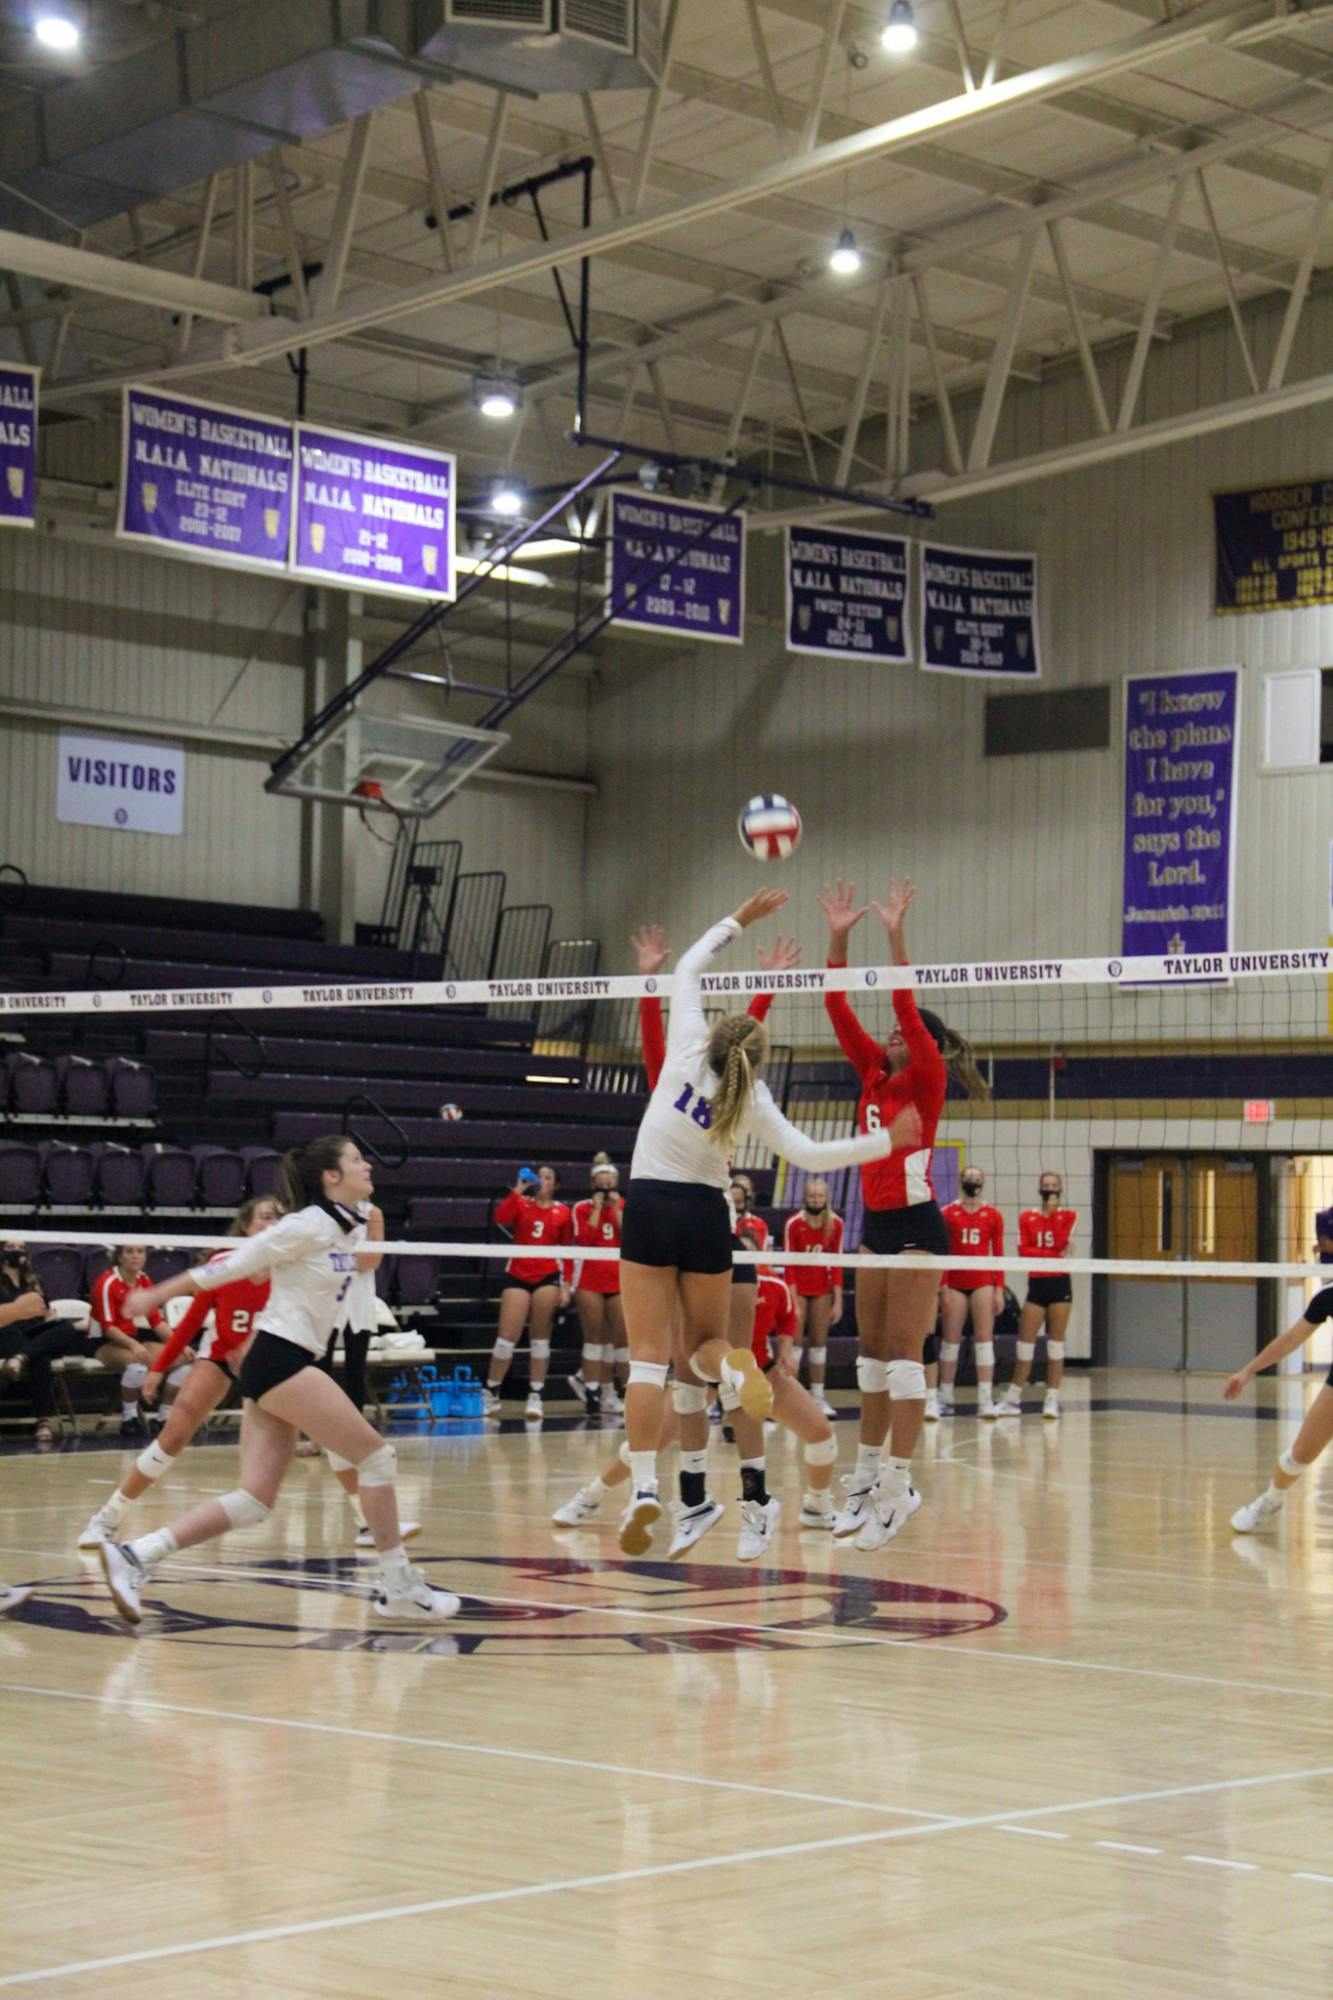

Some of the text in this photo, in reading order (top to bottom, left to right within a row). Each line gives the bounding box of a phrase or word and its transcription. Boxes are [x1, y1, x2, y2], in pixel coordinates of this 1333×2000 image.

[0, 384, 33, 410] ALL
[132, 402, 292, 459] WOMEN'S BASKETBALL
[199, 454, 289, 494] NATIONALS
[301, 446, 450, 499] WOMEN'S BASKETBALL
[362, 493, 444, 530] NATIONALS
[840, 575, 904, 600] NATIONALS
[1160, 690, 1226, 715] know
[1129, 722, 1231, 753] the plans
[68, 756, 175, 795] VISITORS
[1146, 757, 1215, 783] I have
[1132, 792, 1165, 817] for
[1133, 825, 1222, 857] says the
[1148, 859, 1206, 887] Lord.
[915, 963, 1062, 984] TAYLOR UNIVERSITY
[1163, 952, 1329, 975] TAYLOR UNIVERSITY
[302, 986, 413, 1002] TAYLOR UNIVERSITY
[489, 980, 611, 997] TAYLOR UNIVERSITY
[701, 973, 825, 991] AYLOR UNIVERSITY
[9, 996, 66, 1009] UNIVERSITY
[130, 992, 233, 1006] TAYLOR UNIVERSITY
[673, 1082, 712, 1130] 18
[866, 1104, 881, 1132] 6
[532, 1220, 545, 1238] 3
[602, 1222, 614, 1240] 9
[961, 1227, 980, 1245] 16
